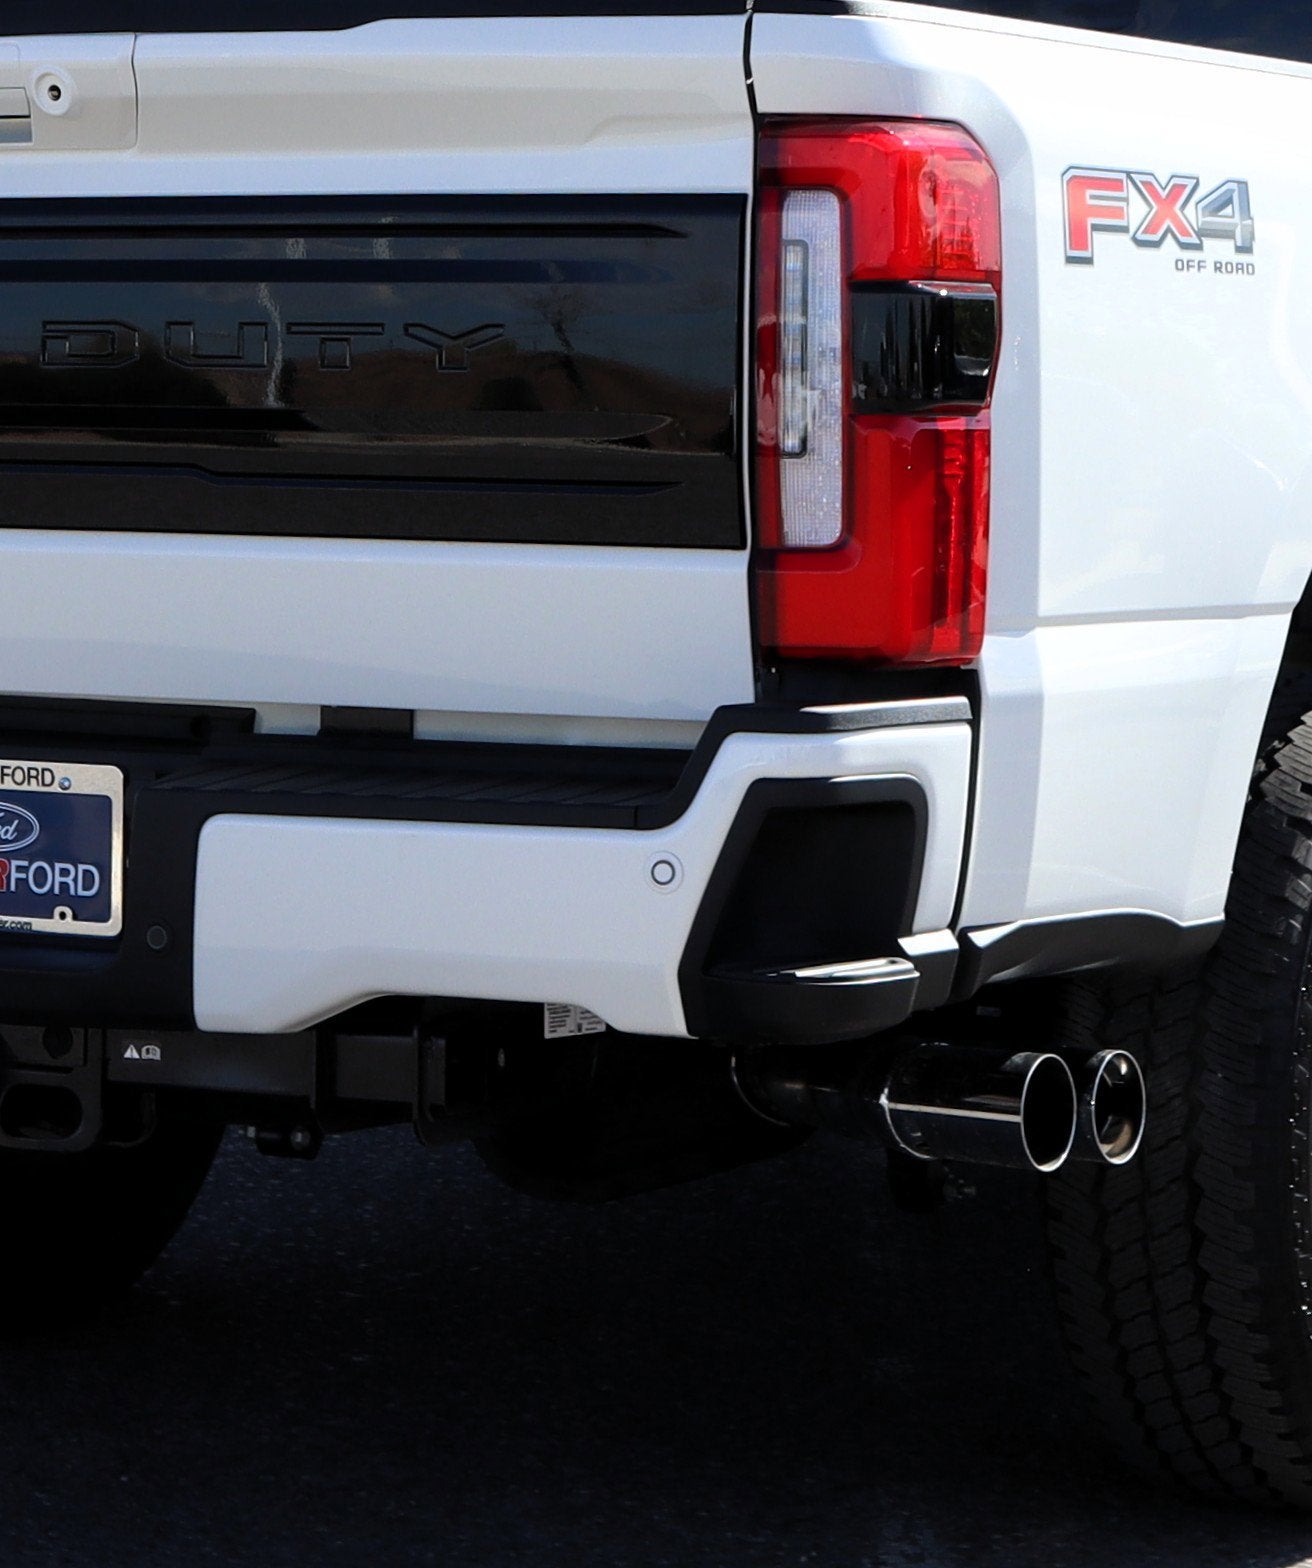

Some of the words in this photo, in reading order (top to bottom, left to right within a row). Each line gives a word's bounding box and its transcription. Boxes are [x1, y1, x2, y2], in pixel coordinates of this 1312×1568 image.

[1061, 164, 1256, 266] FX4
[1174, 258, 1208, 274] OFF
[1213, 260, 1256, 276] ROAD
[40, 320, 506, 371] DUTY
